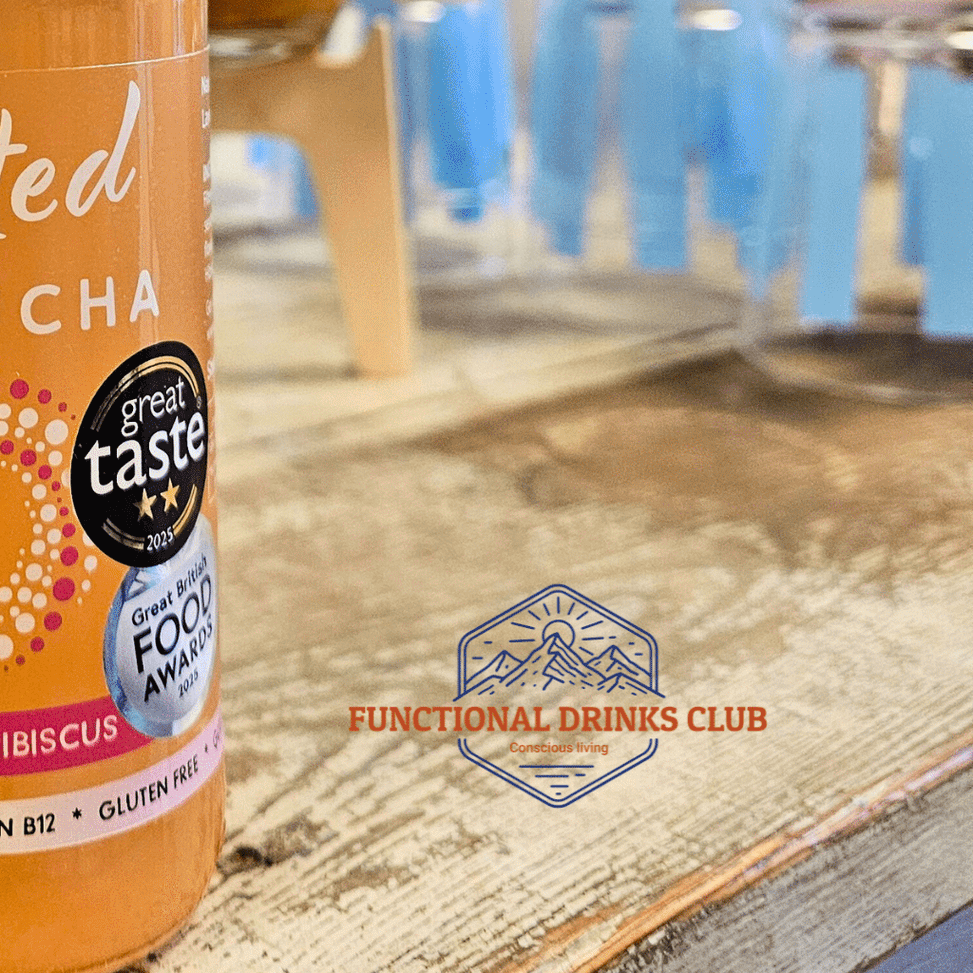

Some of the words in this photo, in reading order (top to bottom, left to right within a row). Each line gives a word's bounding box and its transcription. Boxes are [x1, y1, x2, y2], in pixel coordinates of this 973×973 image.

[120, 375, 187, 437] great
[84, 411, 205, 495] taste
[146, 526, 175, 552] 2025
[131, 589, 174, 627] Great
[176, 552, 208, 599] British
[133, 573, 212, 674] FOOD
[143, 613, 213, 703] AWARDS
[23, 812, 57, 836] B12
[98, 775, 169, 821] GLUTEN
[173, 753, 199, 790] FREE
